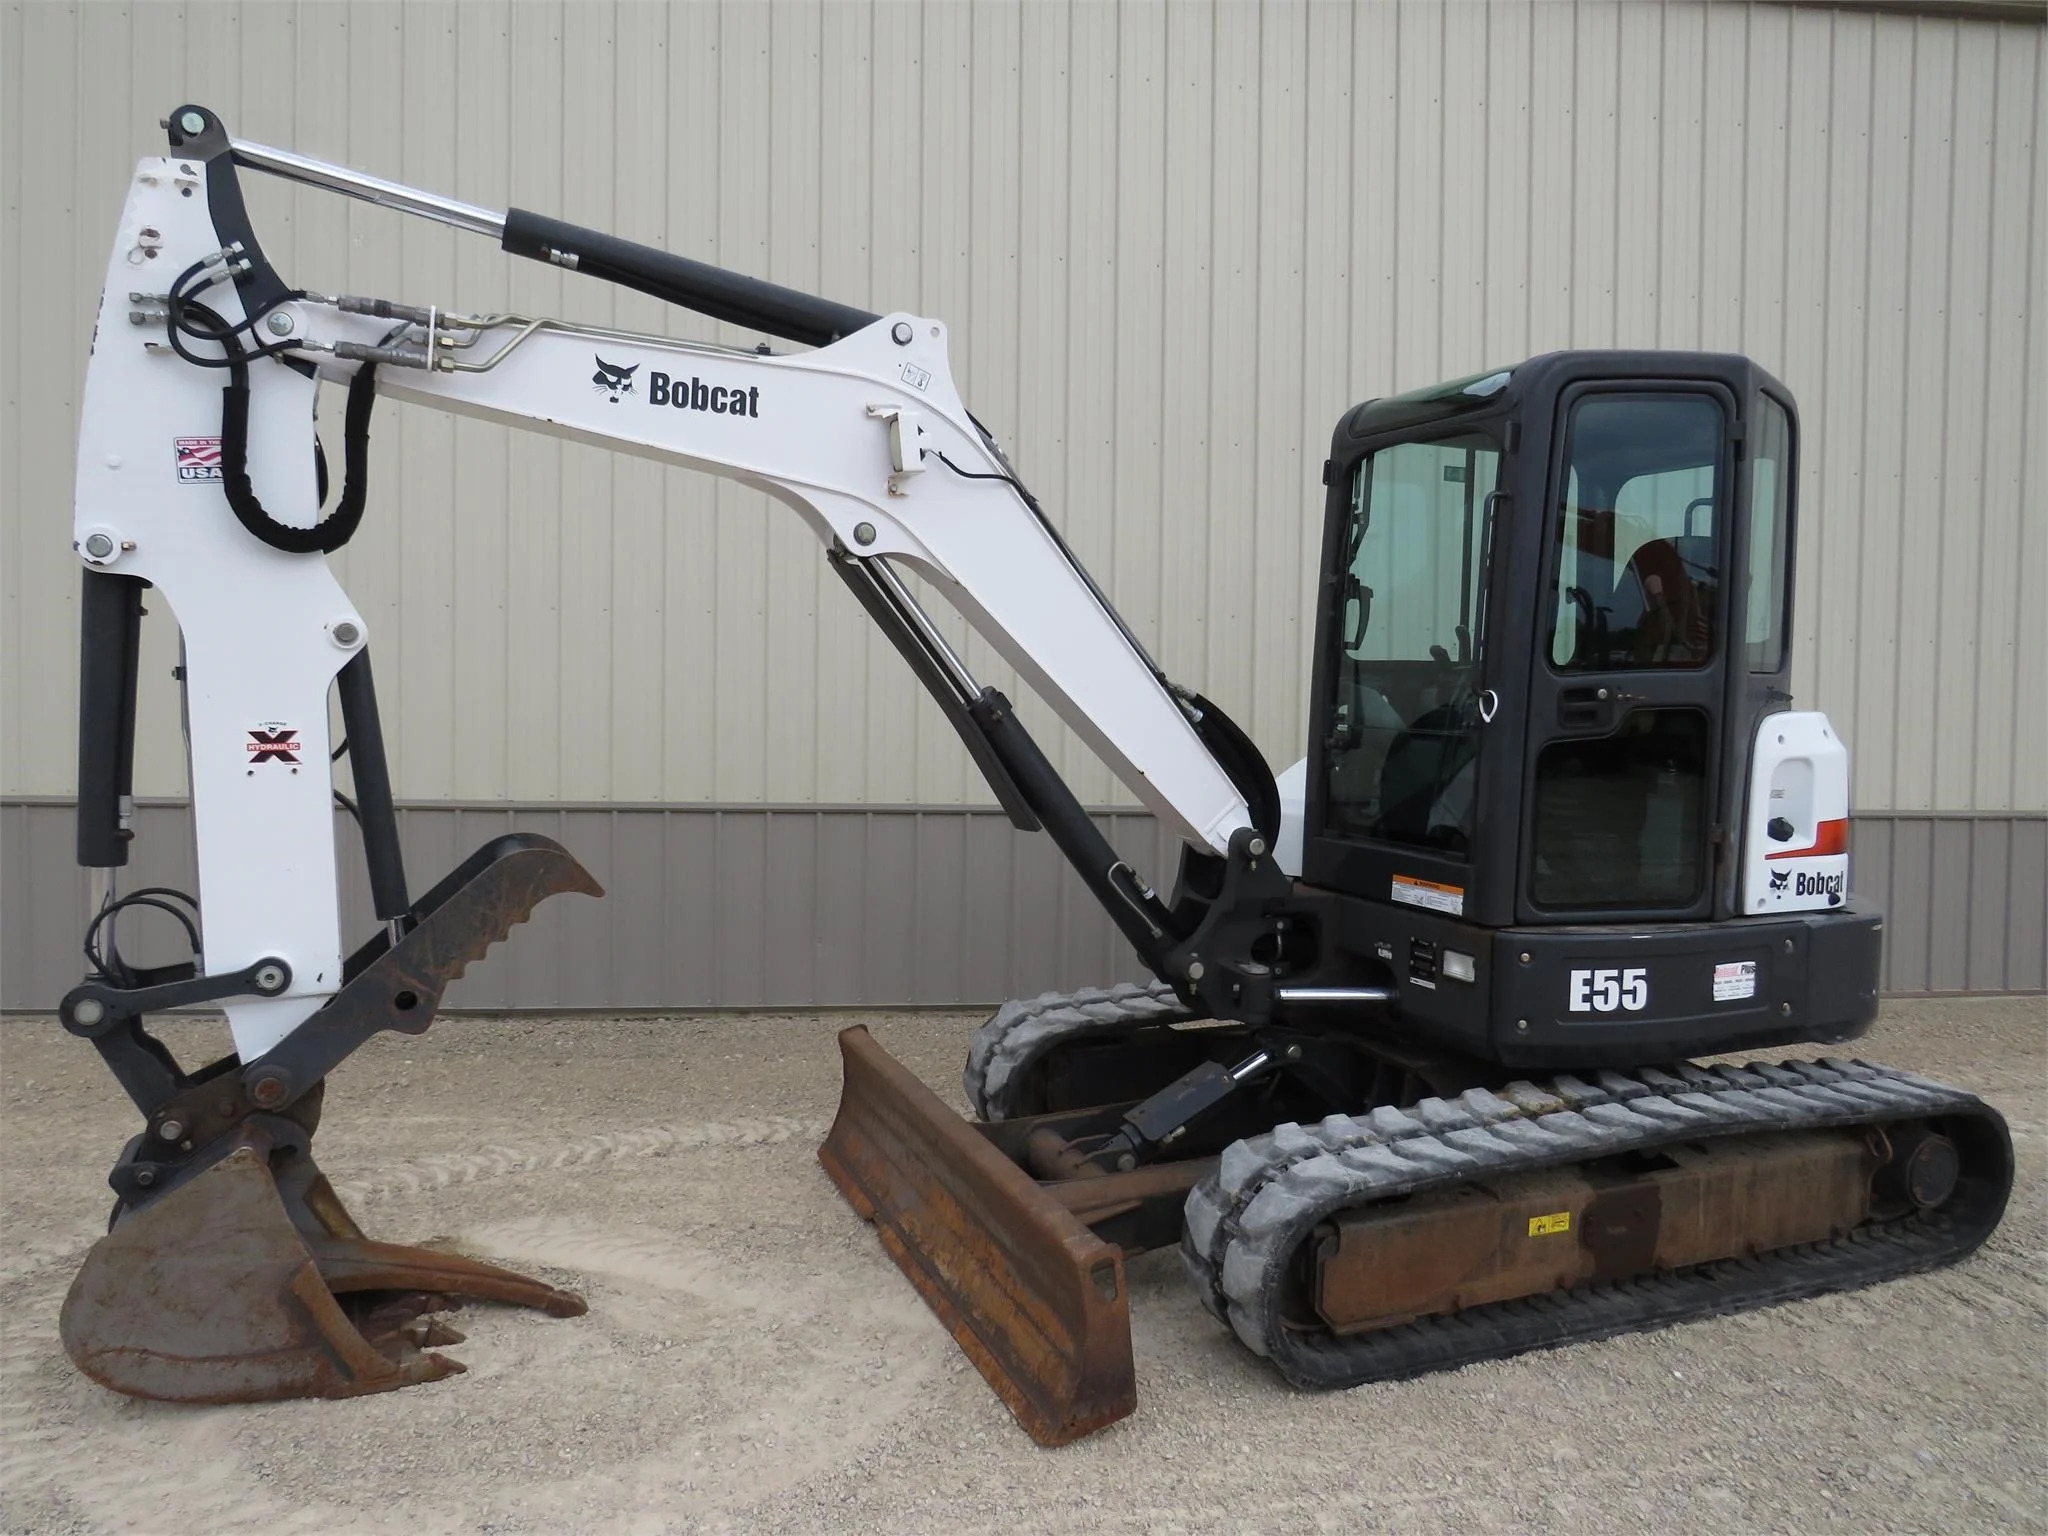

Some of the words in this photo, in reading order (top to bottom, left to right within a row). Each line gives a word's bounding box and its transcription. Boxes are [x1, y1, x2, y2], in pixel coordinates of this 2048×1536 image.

[649, 371, 760, 419] Bobcat
[181, 467, 224, 479] USA
[248, 743, 299, 751] HYDRAULIC
[1795, 870, 1844, 897] Bobcat
[1569, 968, 1648, 1012] E55
